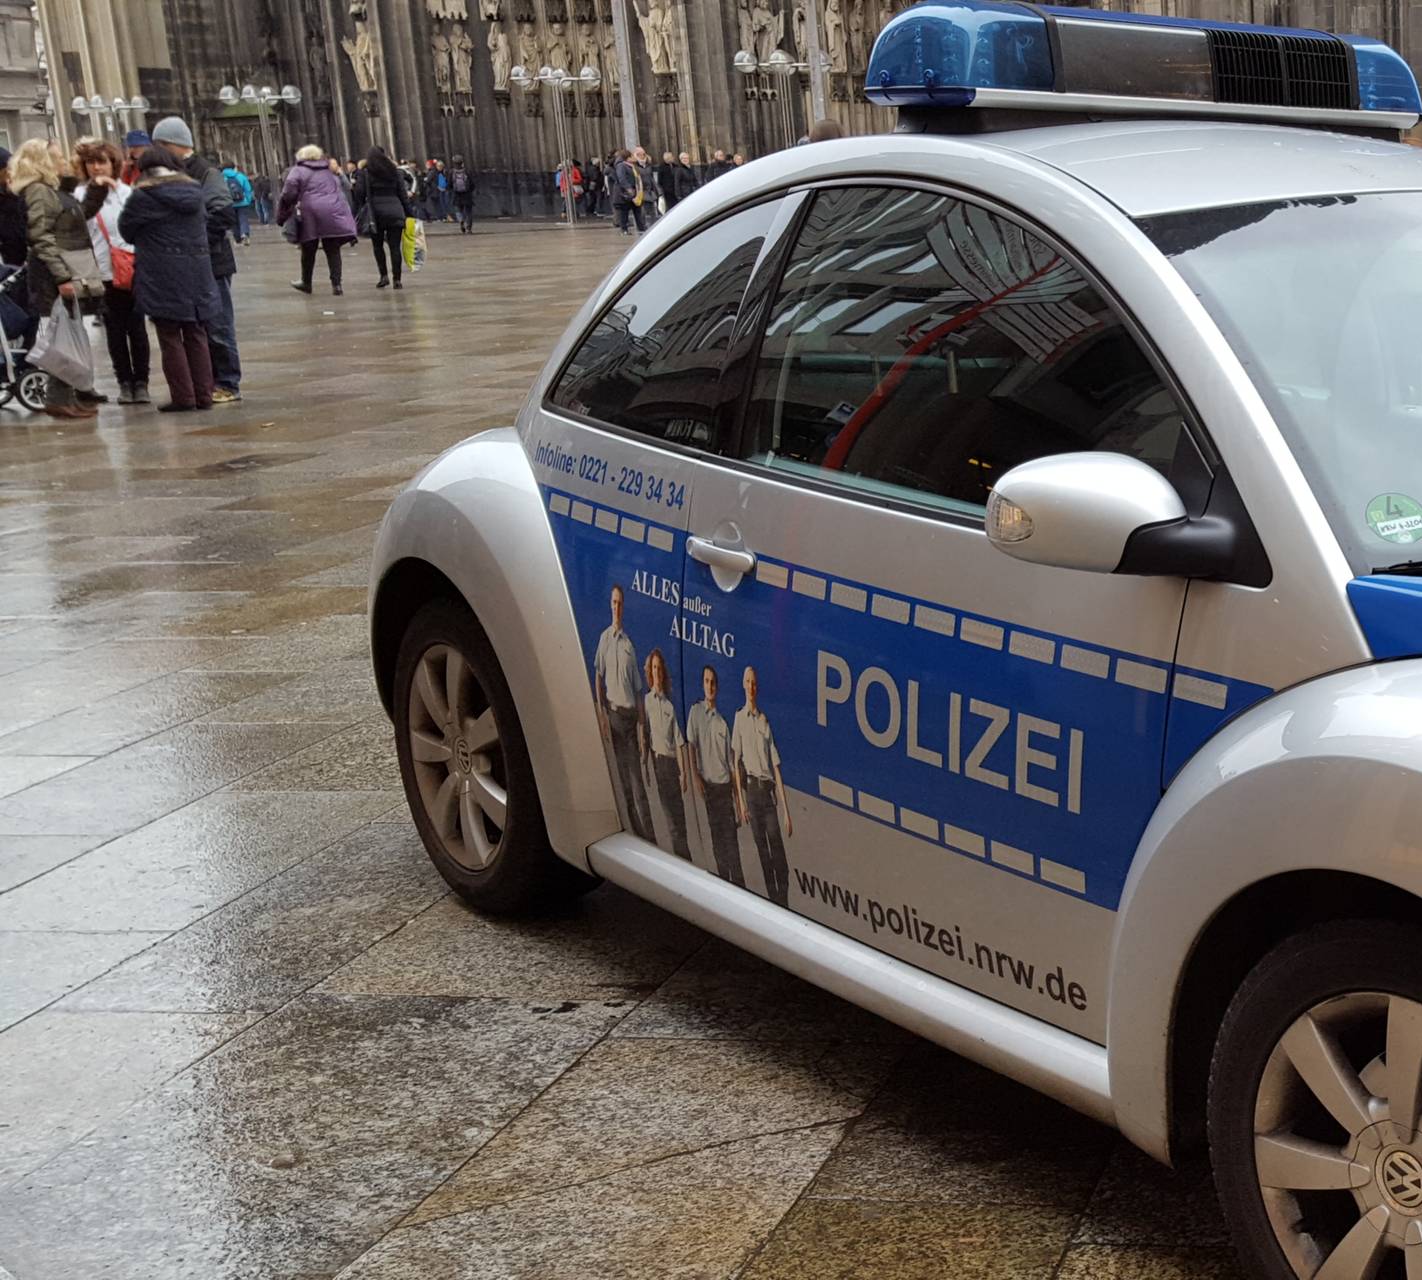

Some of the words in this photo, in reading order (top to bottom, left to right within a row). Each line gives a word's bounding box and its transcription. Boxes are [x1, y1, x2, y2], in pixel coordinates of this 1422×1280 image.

[535, 440, 577, 475] Infoline:
[579, 454, 608, 485] 0221
[618, 467, 643, 496] 229
[646, 476, 664, 503] 34
[666, 481, 685, 510] 34
[631, 569, 680, 606] ALLES
[683, 596, 712, 616] außer
[669, 615, 735, 658] ALLTAG
[816, 649, 1084, 815] POLIZEI
[794, 868, 1087, 1011] www.polizei.nrw.de
